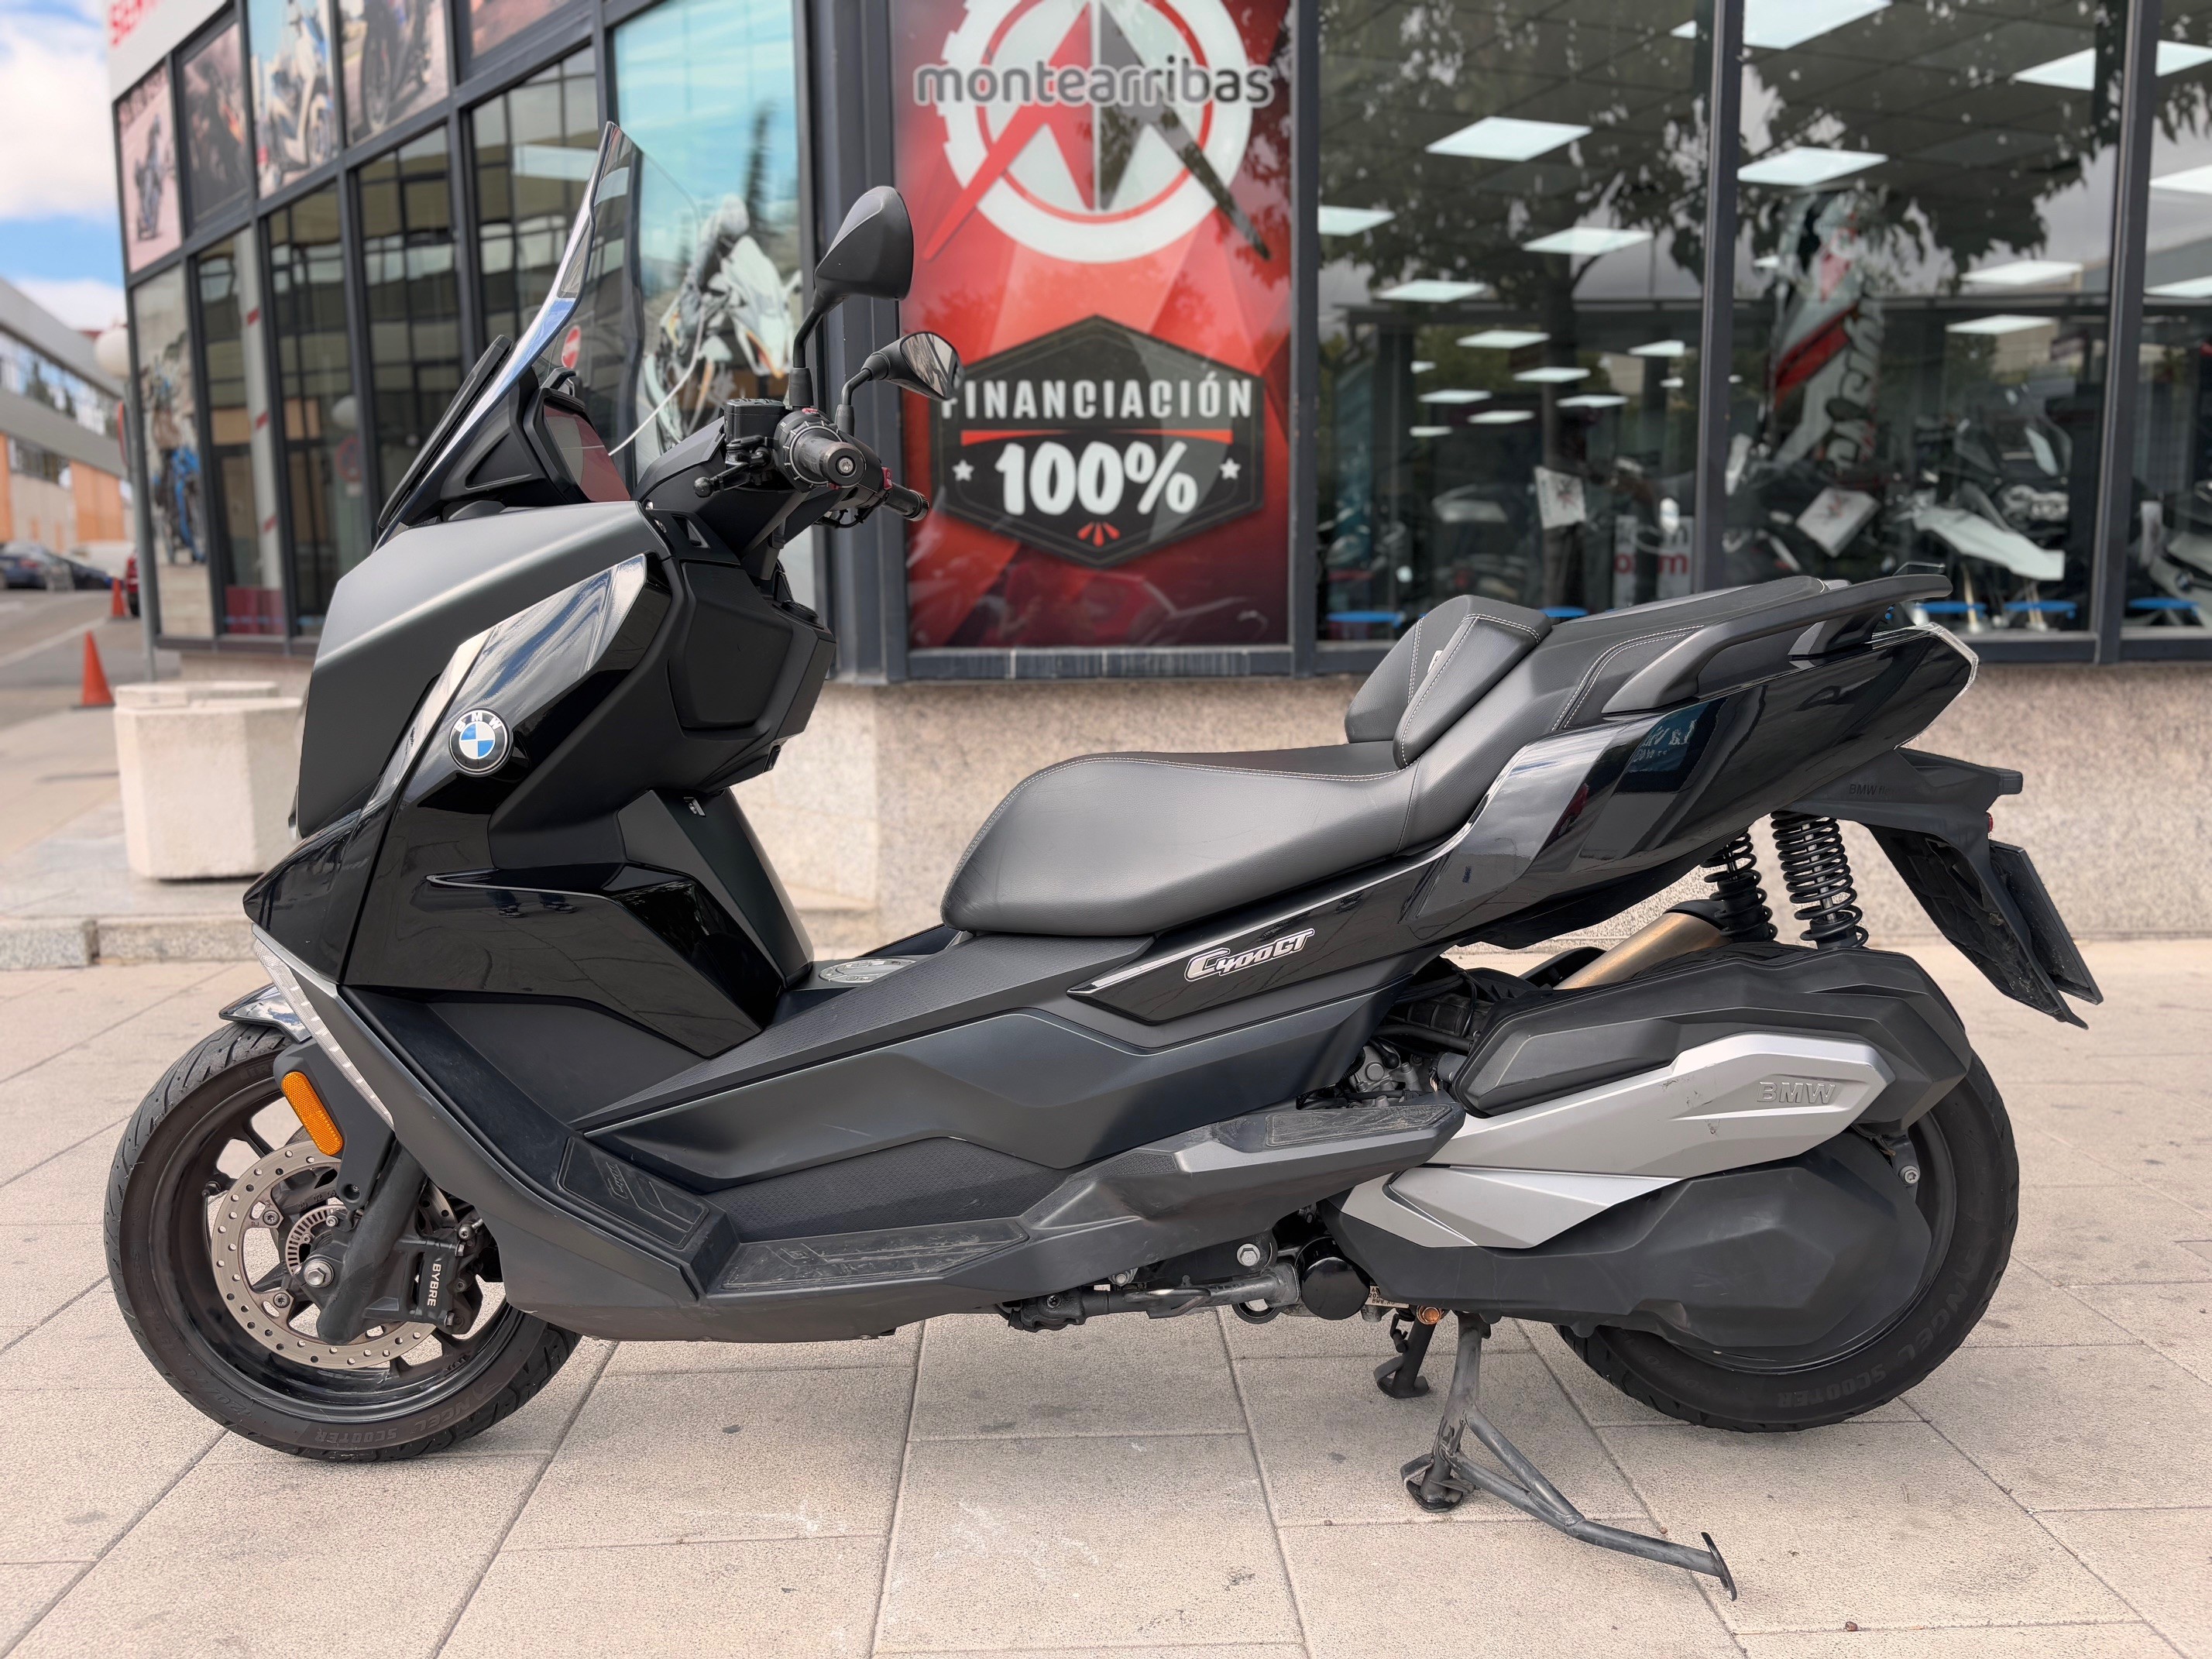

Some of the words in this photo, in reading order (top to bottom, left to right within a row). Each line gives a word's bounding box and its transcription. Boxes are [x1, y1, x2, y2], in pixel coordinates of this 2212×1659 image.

[915, 53, 1273, 105] montearribas
[994, 440, 1198, 516] 100%
[454, 711, 503, 733] BMW
[1848, 783, 1877, 796] BMW
[1756, 1081, 1836, 1104] BMW
[426, 1262, 442, 1307] BYBRE
[1777, 1363, 1887, 1409] SCOOTER
[314, 1427, 398, 1444] SCOOTER
